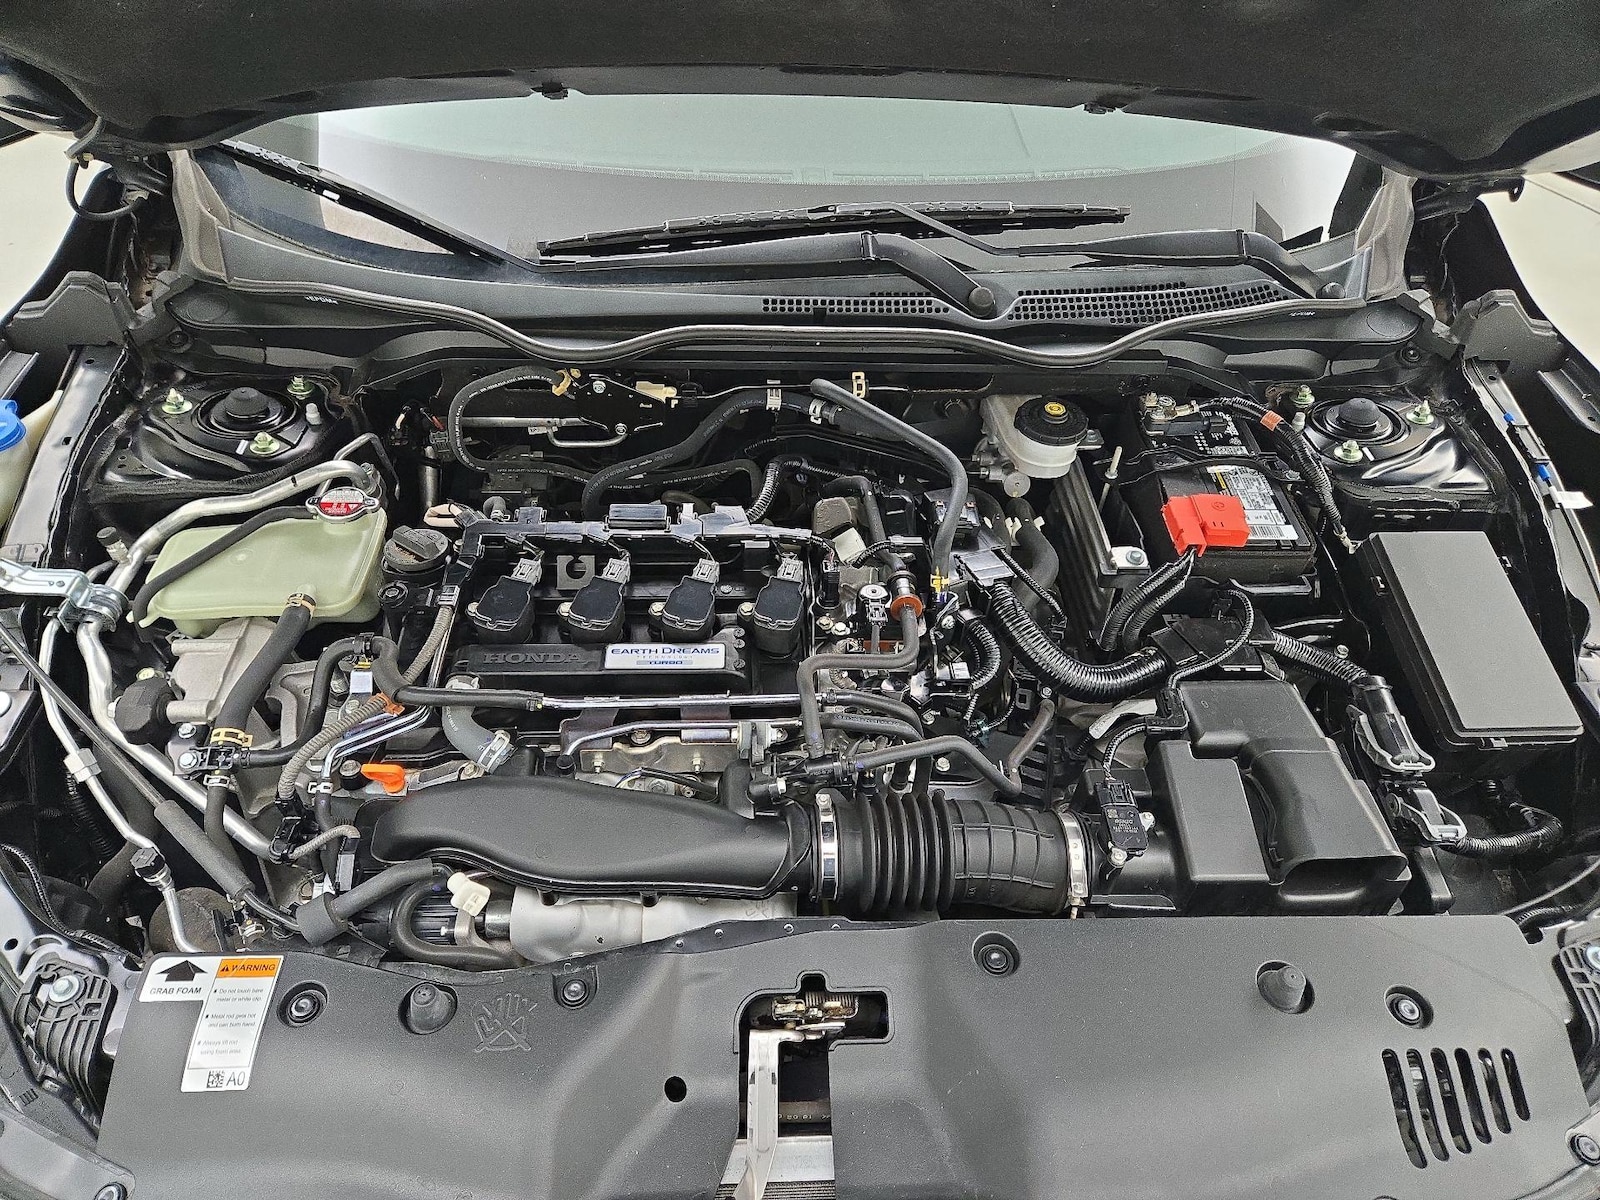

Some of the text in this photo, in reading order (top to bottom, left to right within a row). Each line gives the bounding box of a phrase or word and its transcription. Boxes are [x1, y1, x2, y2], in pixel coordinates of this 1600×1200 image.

[662, 647, 720, 655] DREAMS
[482, 652, 586, 665] HONDA
[231, 964, 276, 972] WARNING
[149, 987, 202, 995] GRAB FOAM
[226, 1071, 246, 1086] A0
